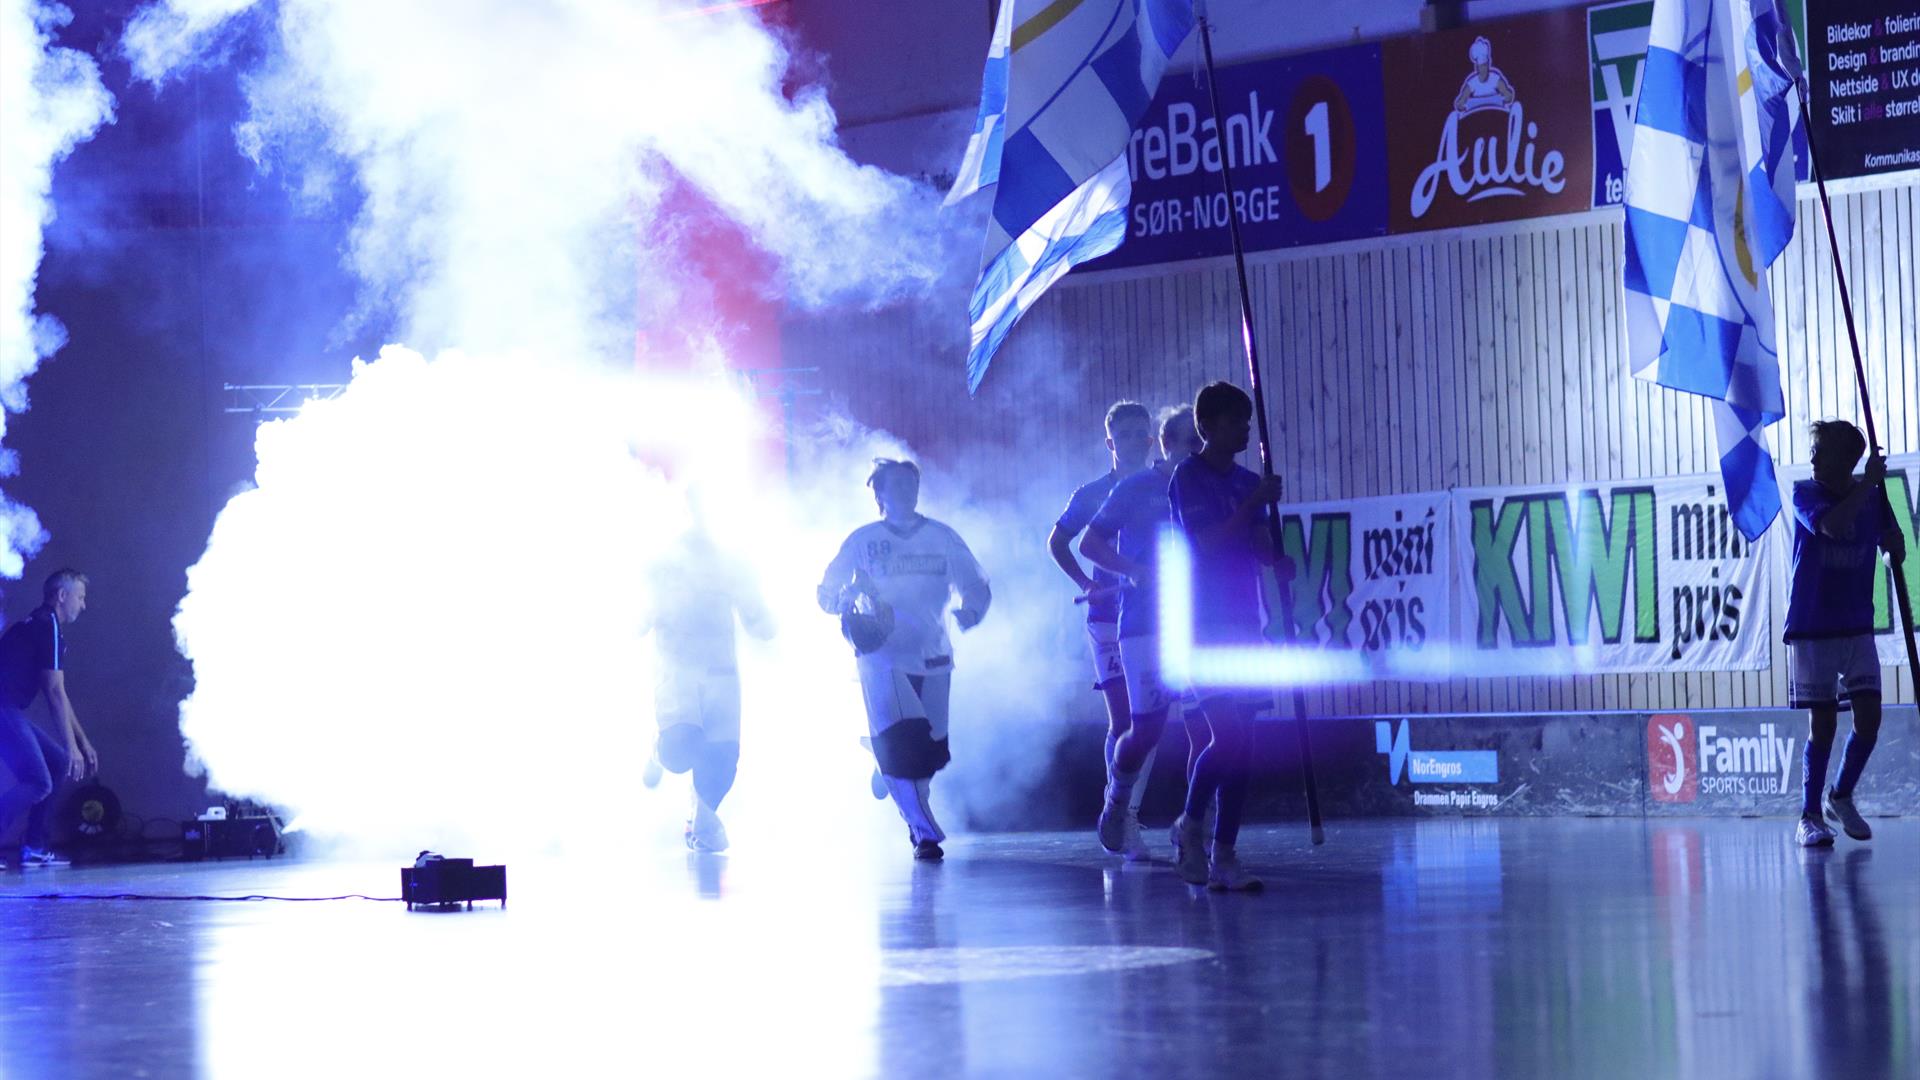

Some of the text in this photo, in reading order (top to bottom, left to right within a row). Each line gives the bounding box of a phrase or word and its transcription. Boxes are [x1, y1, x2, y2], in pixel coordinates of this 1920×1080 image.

[1827, 22, 1872, 44] Bildekor
[1828, 50, 1867, 72] Design
[1829, 74, 1879, 98] Nettside
[1891, 68, 1909, 89] UX
[1831, 104, 1856, 126] Skilt
[1857, 103, 1862, 122] i
[1304, 101, 1332, 193] 1
[1410, 101, 1566, 218] Aulie
[1134, 185, 1280, 237] SØR-NORGE
[1363, 507, 1435, 580] mini
[1671, 485, 1750, 561] min
[1470, 486, 1660, 650] KIWI
[1360, 580, 1426, 660] pris
[1672, 566, 1743, 660] pris
[1413, 758, 1462, 778] NorEngros
[1699, 723, 1795, 794] Family
[1702, 776, 1778, 794] SPORTS CLUB
[1414, 790, 1498, 808] Drammen Papir Engros
